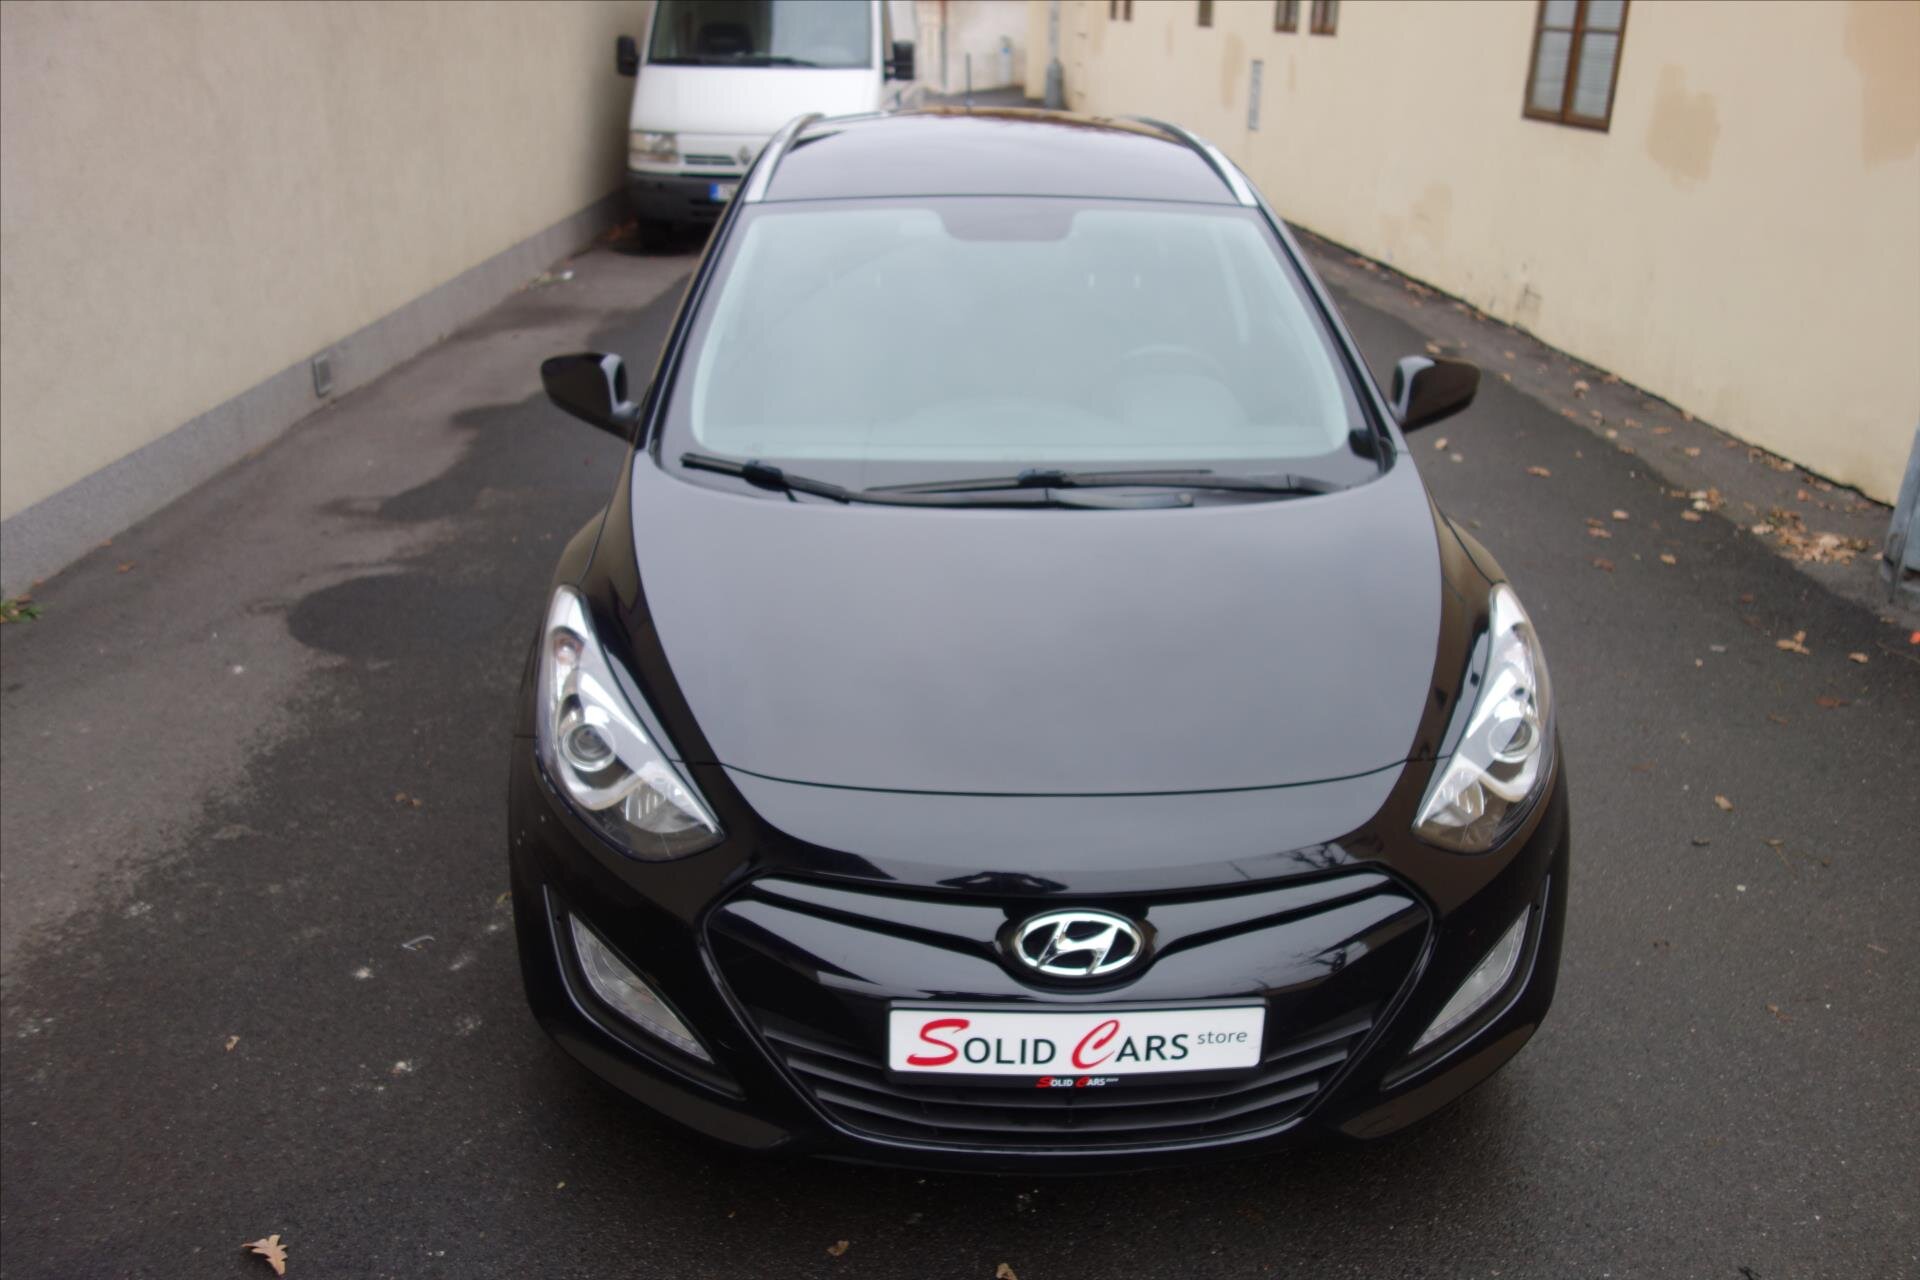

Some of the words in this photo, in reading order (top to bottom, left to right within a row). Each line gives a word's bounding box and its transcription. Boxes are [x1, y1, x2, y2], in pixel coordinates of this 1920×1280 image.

[907, 1018, 1056, 1067] SOLID
[1071, 1019, 1189, 1069] CARS
[1196, 1030, 1248, 1045] store
[1036, 1075, 1073, 1088] SOLID
[1075, 1075, 1106, 1088] CARS
